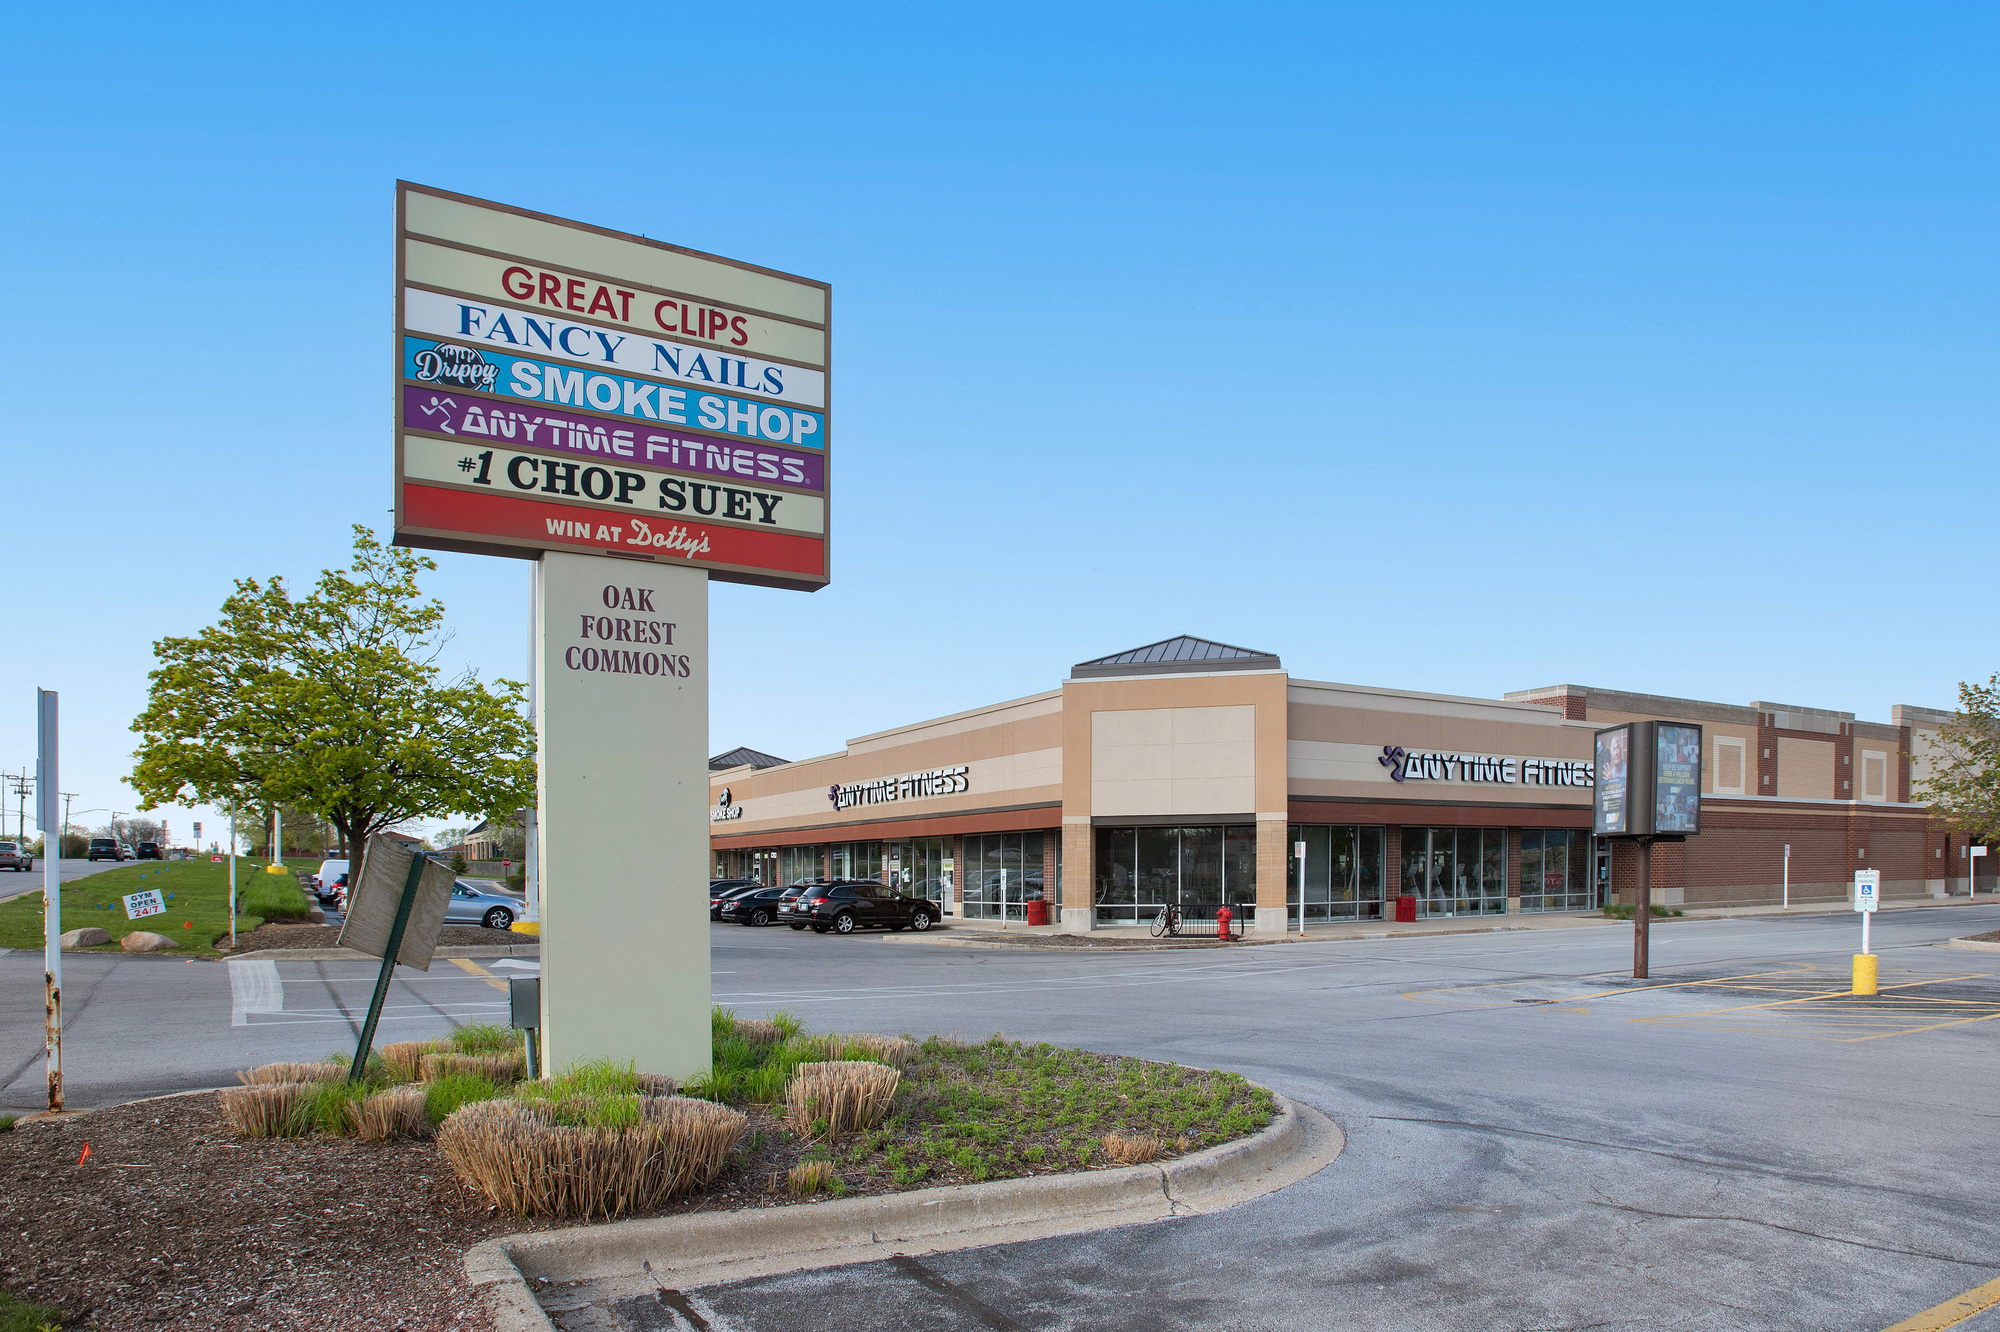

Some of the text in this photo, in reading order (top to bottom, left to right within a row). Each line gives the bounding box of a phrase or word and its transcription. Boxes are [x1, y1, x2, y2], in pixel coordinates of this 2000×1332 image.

[502, 266, 748, 346] GREAT CLIPS
[456, 303, 784, 394] FANCY NAILS
[414, 350, 818, 444] Drippy SMOKE SHOP
[461, 406, 634, 457] ANYTIME
[458, 450, 783, 525] #1 CHOP SUEY
[546, 518, 710, 558] WIN AT Dotty's
[602, 585, 656, 612] OAK
[580, 614, 676, 646] FOREST
[565, 646, 690, 678] COMMONS
[838, 766, 968, 808] ANYTIME FITNESS
[1404, 752, 1594, 787] ANYTIME FITNES
[727, 806, 741, 819] SHOP
[130, 892, 153, 902] GYM
[130, 898, 157, 909] OPEN
[134, 905, 159, 917] 24/7
